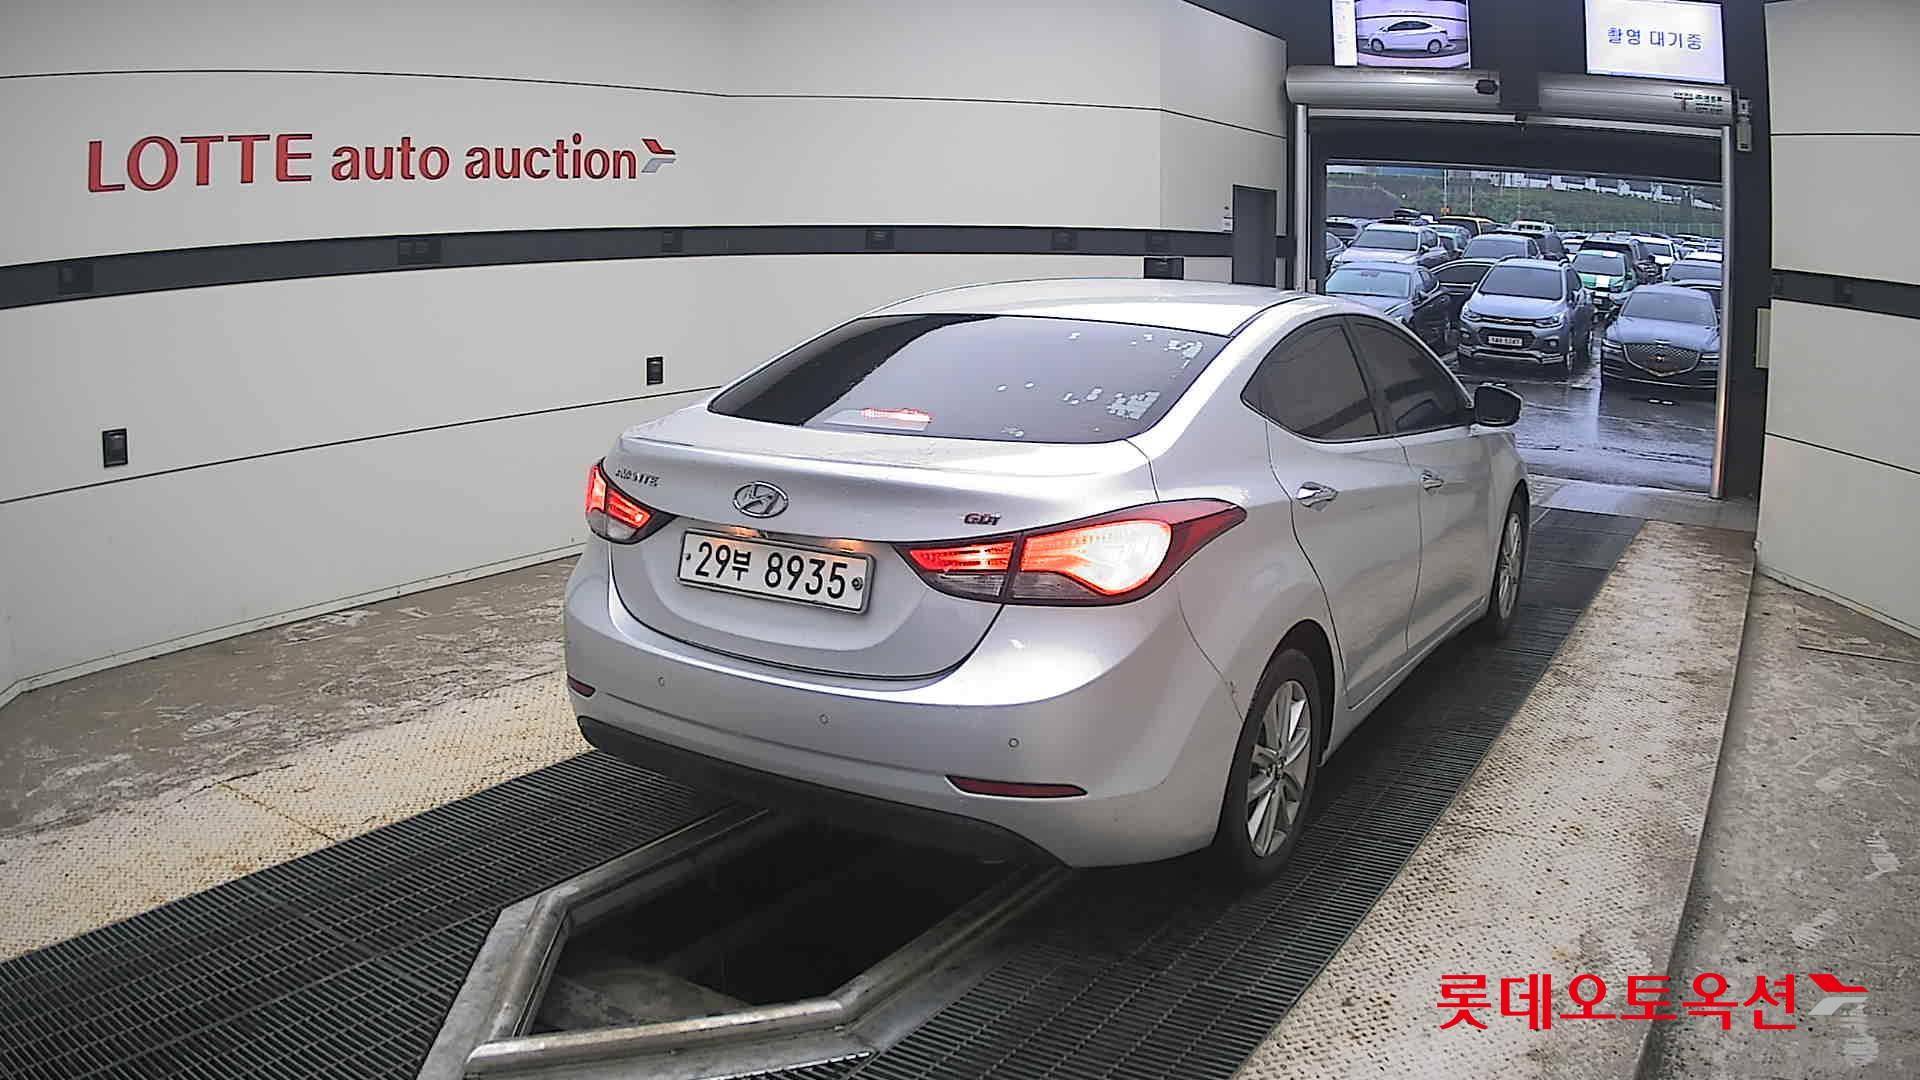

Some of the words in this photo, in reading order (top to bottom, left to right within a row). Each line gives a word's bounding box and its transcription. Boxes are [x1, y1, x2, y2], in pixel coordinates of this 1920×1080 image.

[1608, 27, 1641, 46] 촬영
[1649, 30, 1702, 50] 대기중
[88, 134, 313, 192] LOTTE
[331, 136, 450, 181] auto
[464, 132, 638, 180] auction
[695, 541, 751, 581] 29부
[764, 552, 848, 599] 8935
